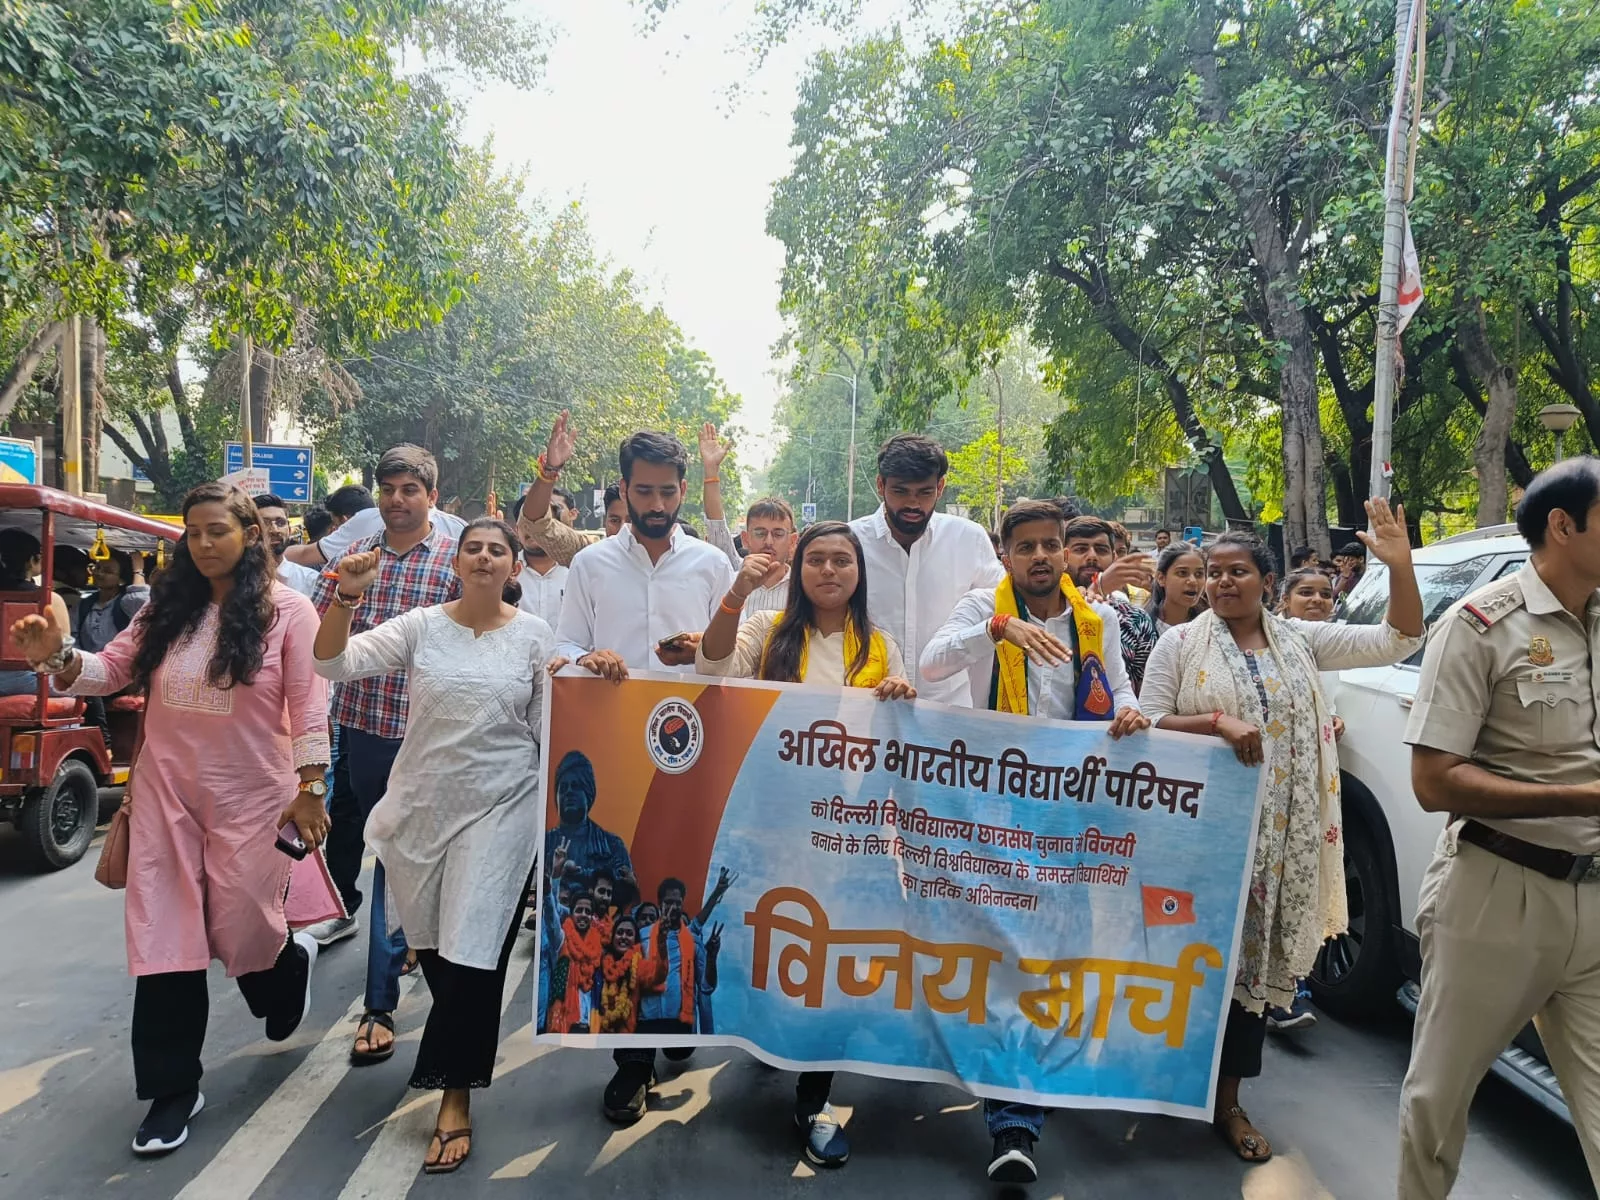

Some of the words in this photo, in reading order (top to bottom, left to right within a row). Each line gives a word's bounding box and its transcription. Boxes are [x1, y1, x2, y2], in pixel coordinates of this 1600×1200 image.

[778, 719, 881, 773] अखिल
[884, 738, 994, 793] भारतीय
[997, 748, 1107, 802] विद्यार्थी
[1104, 761, 1204, 818] परिषद
[811, 798, 829, 820] को
[830, 795, 878, 826] दिल्ली
[880, 799, 976, 842] विश्वविद्यालय
[977, 824, 1034, 851] छात्रसंघ
[1035, 835, 1075, 858] चुनाव
[1084, 827, 1136, 858] विजयी
[811, 830, 844, 855] बनाने
[845, 834, 861, 856] के
[863, 834, 891, 856] लिए
[893, 836, 931, 868] दिल्ली
[933, 847, 1013, 880] विश्वविद्यालय
[1015, 858, 1030, 880] के
[1035, 865, 1076, 884] समस्त
[902, 872, 917, 893] का
[920, 876, 964, 899] हार्दिक
[744, 886, 1003, 1024] विजय
[1016, 943, 1224, 1048] मार्च
